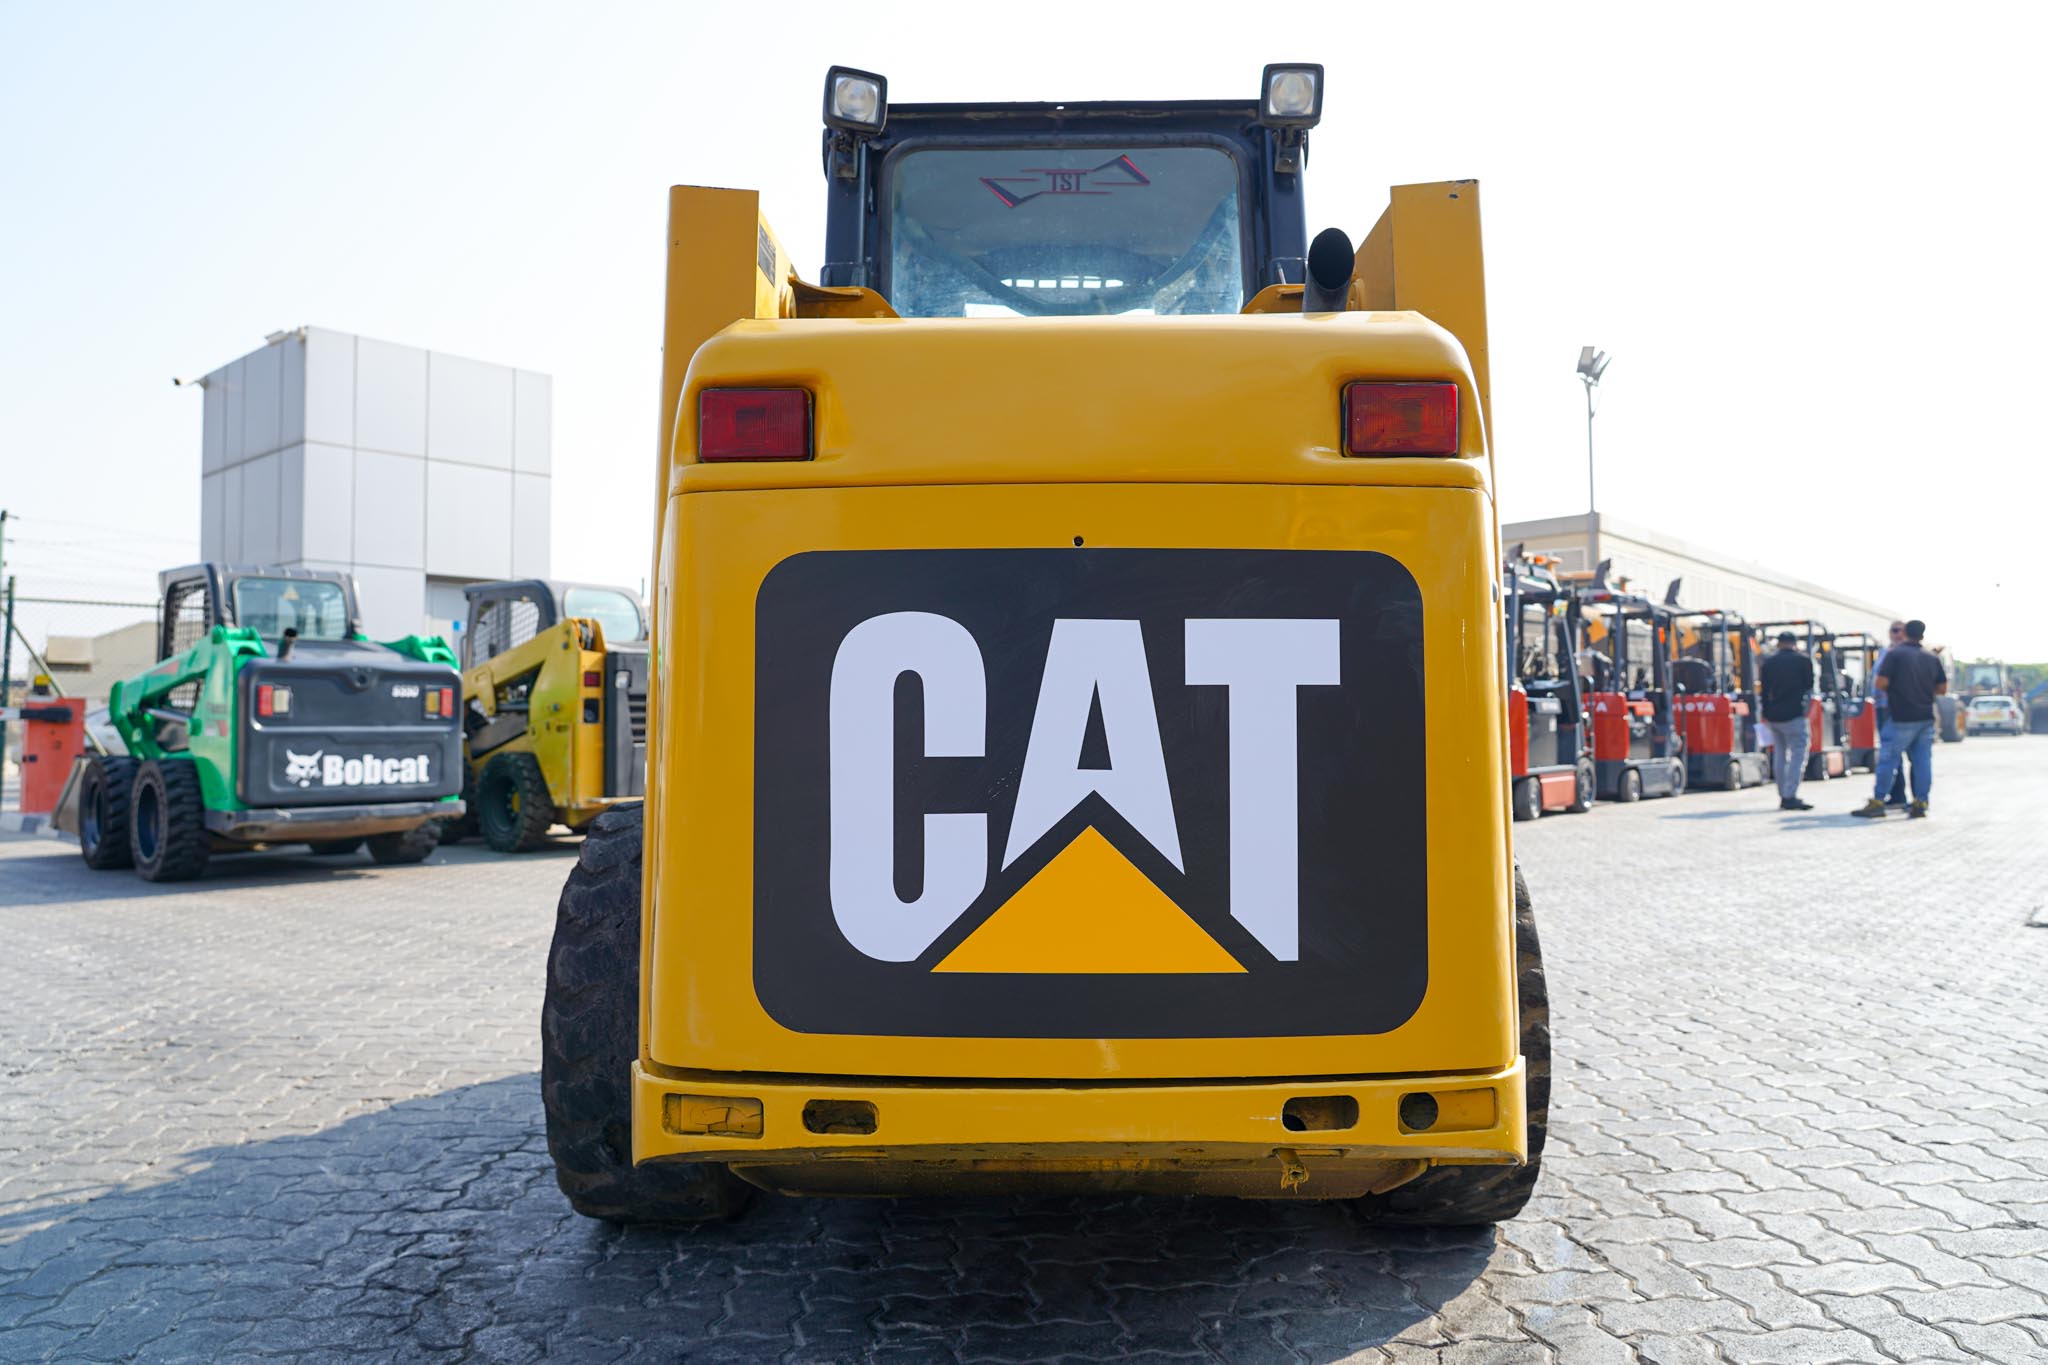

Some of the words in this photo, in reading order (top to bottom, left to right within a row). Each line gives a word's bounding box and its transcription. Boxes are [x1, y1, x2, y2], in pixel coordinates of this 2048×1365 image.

[1045, 171, 1088, 192] TST
[322, 754, 430, 786] Bobcat
[830, 611, 1341, 963] CAT
